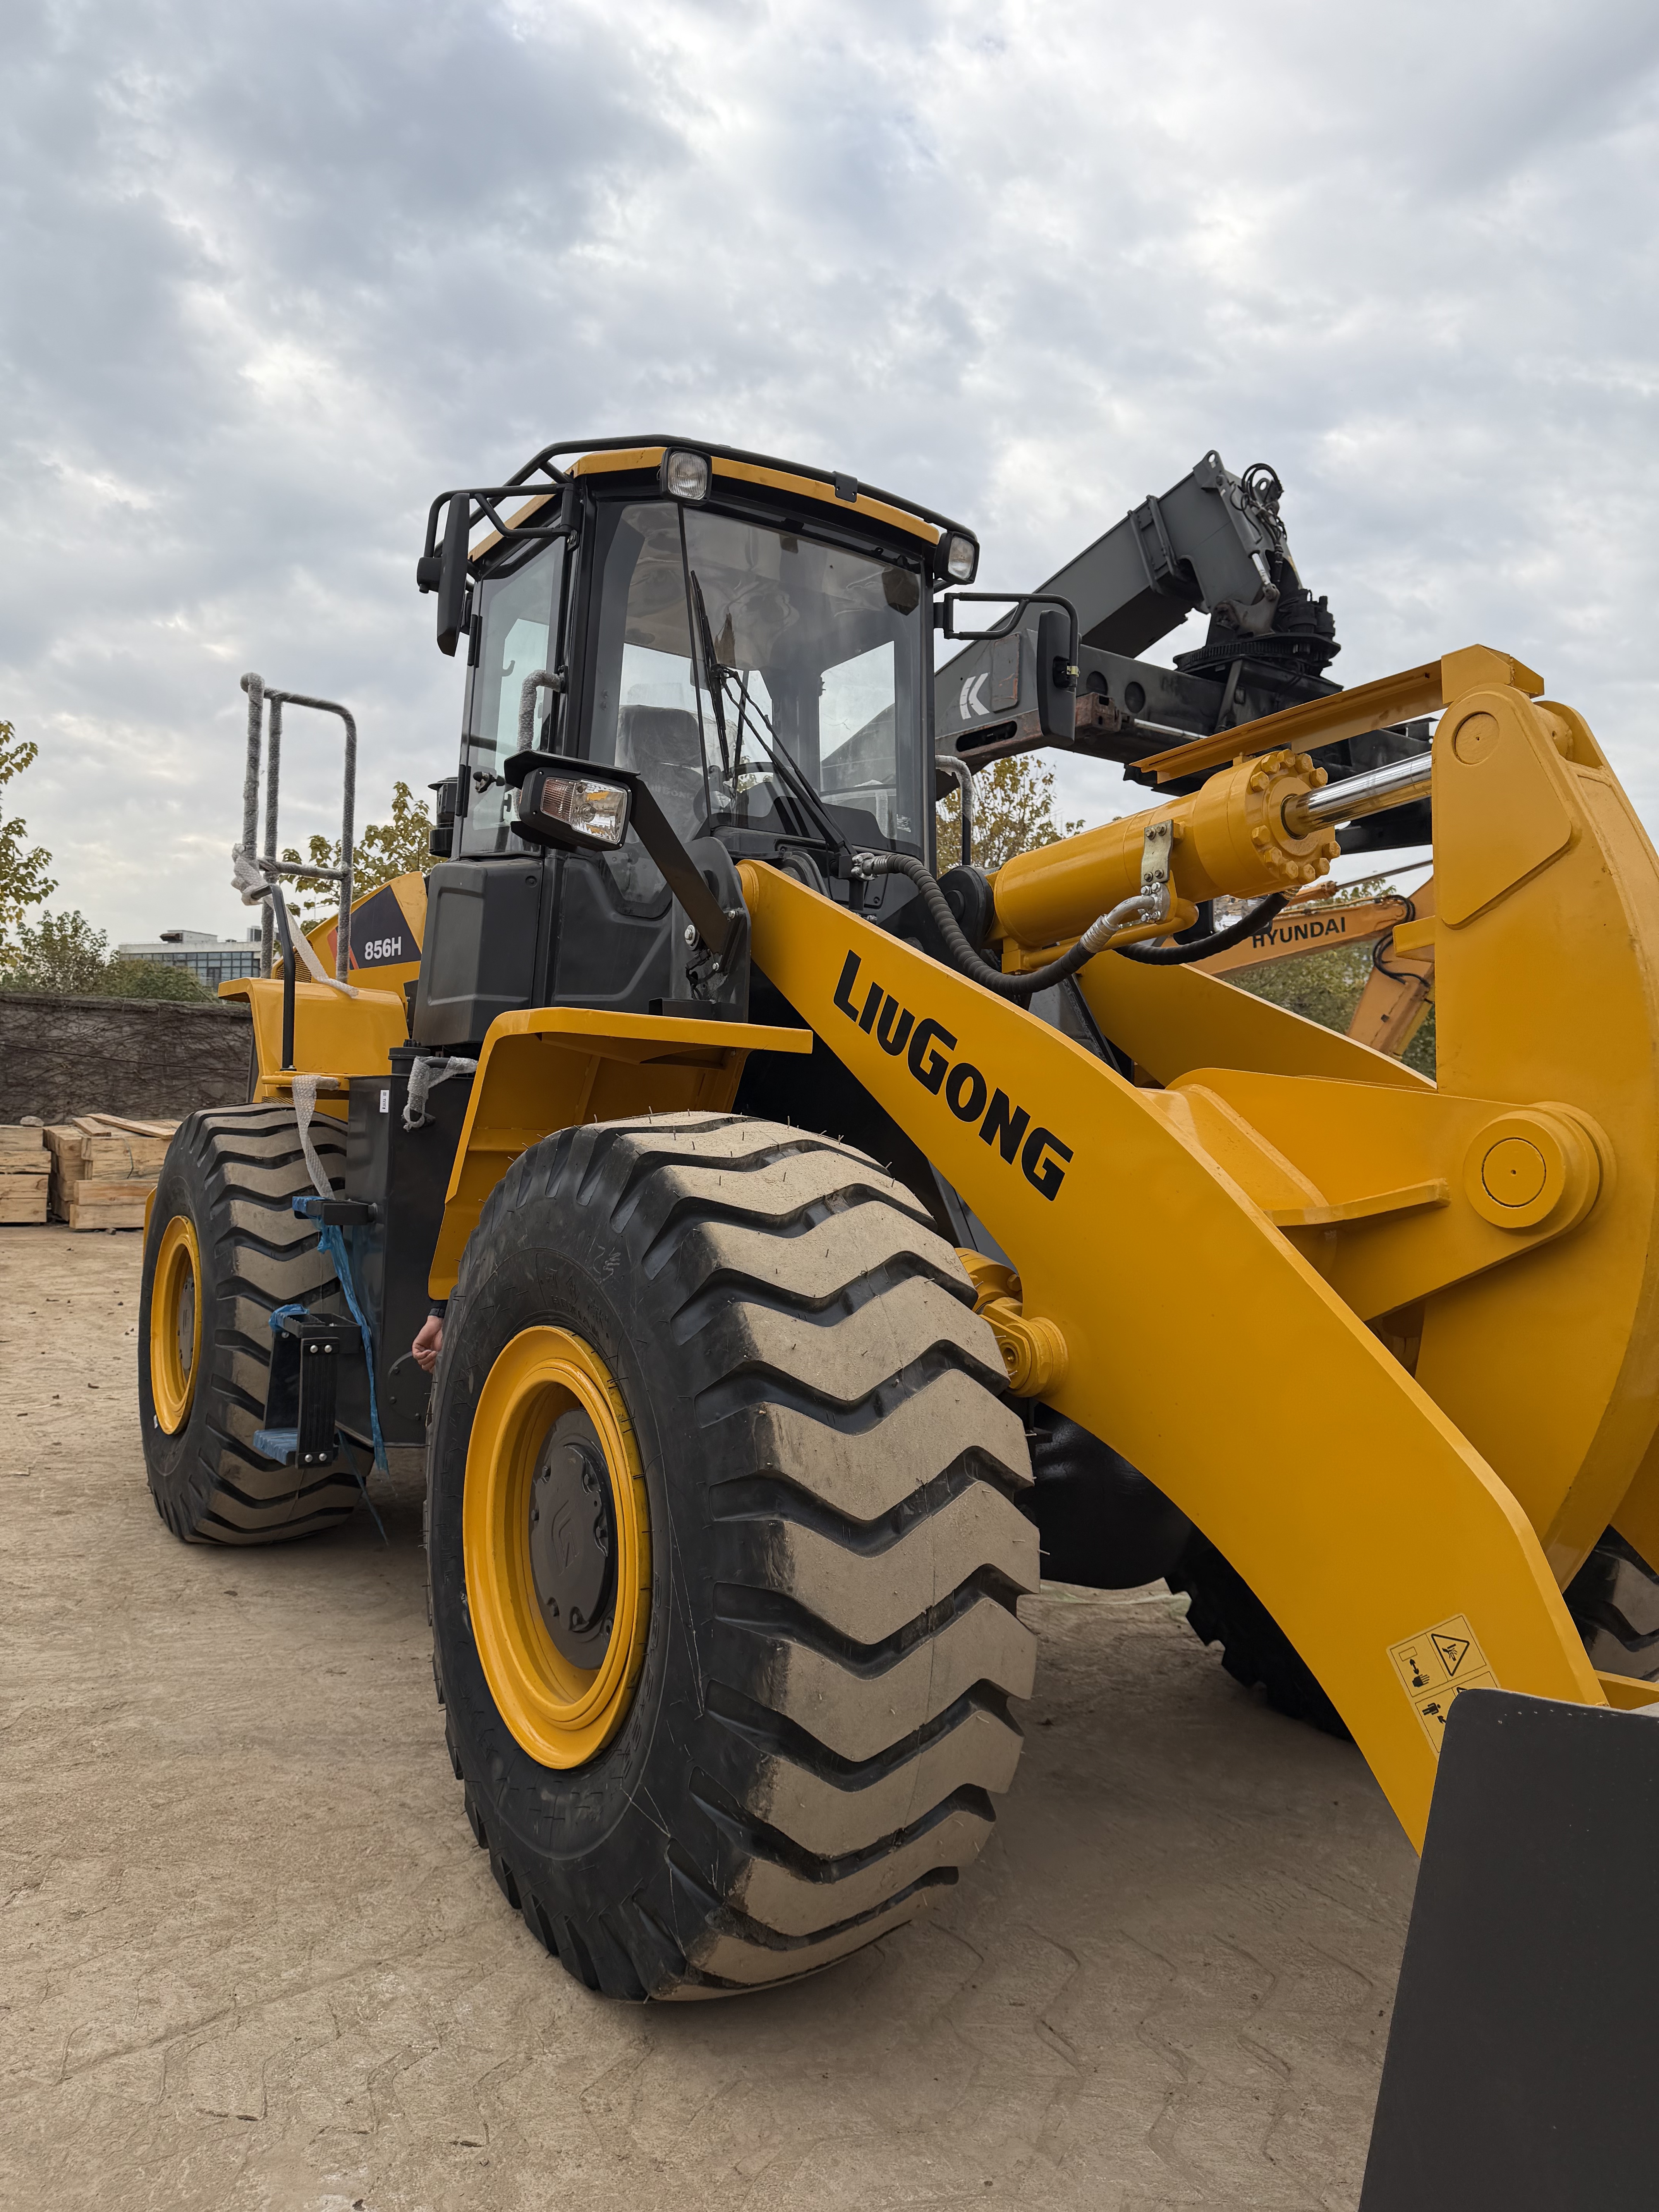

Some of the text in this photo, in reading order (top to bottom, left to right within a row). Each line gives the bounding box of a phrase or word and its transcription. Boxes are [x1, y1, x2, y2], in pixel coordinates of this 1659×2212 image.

[364, 936, 402, 960] 856H
[1252, 917, 1346, 948] HYUNDAI
[833, 949, 1074, 1202] LIUGONG
